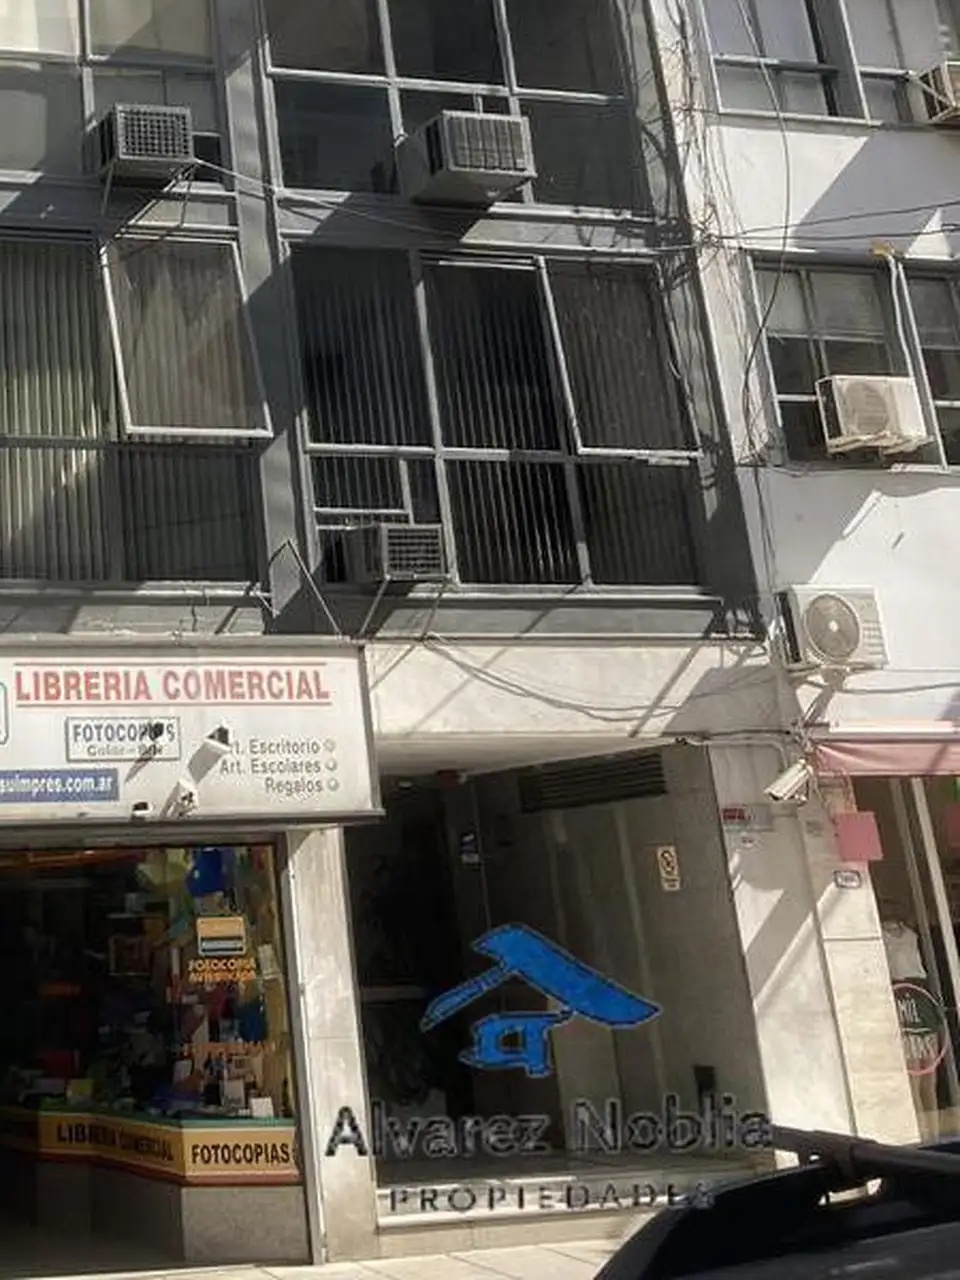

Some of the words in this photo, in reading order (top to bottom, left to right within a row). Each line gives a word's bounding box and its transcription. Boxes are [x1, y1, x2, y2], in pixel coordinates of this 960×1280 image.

[14, 670, 152, 702] LIBRERIA
[162, 669, 331, 701] COMERCIAL
[72, 722, 175, 742] FOTOCOPS
[249, 740, 321, 756] Escritorio
[251, 759, 321, 775] Escolares
[265, 777, 323, 797] Regalos
[191, 1142, 291, 1165] FOTOCOPIAS
